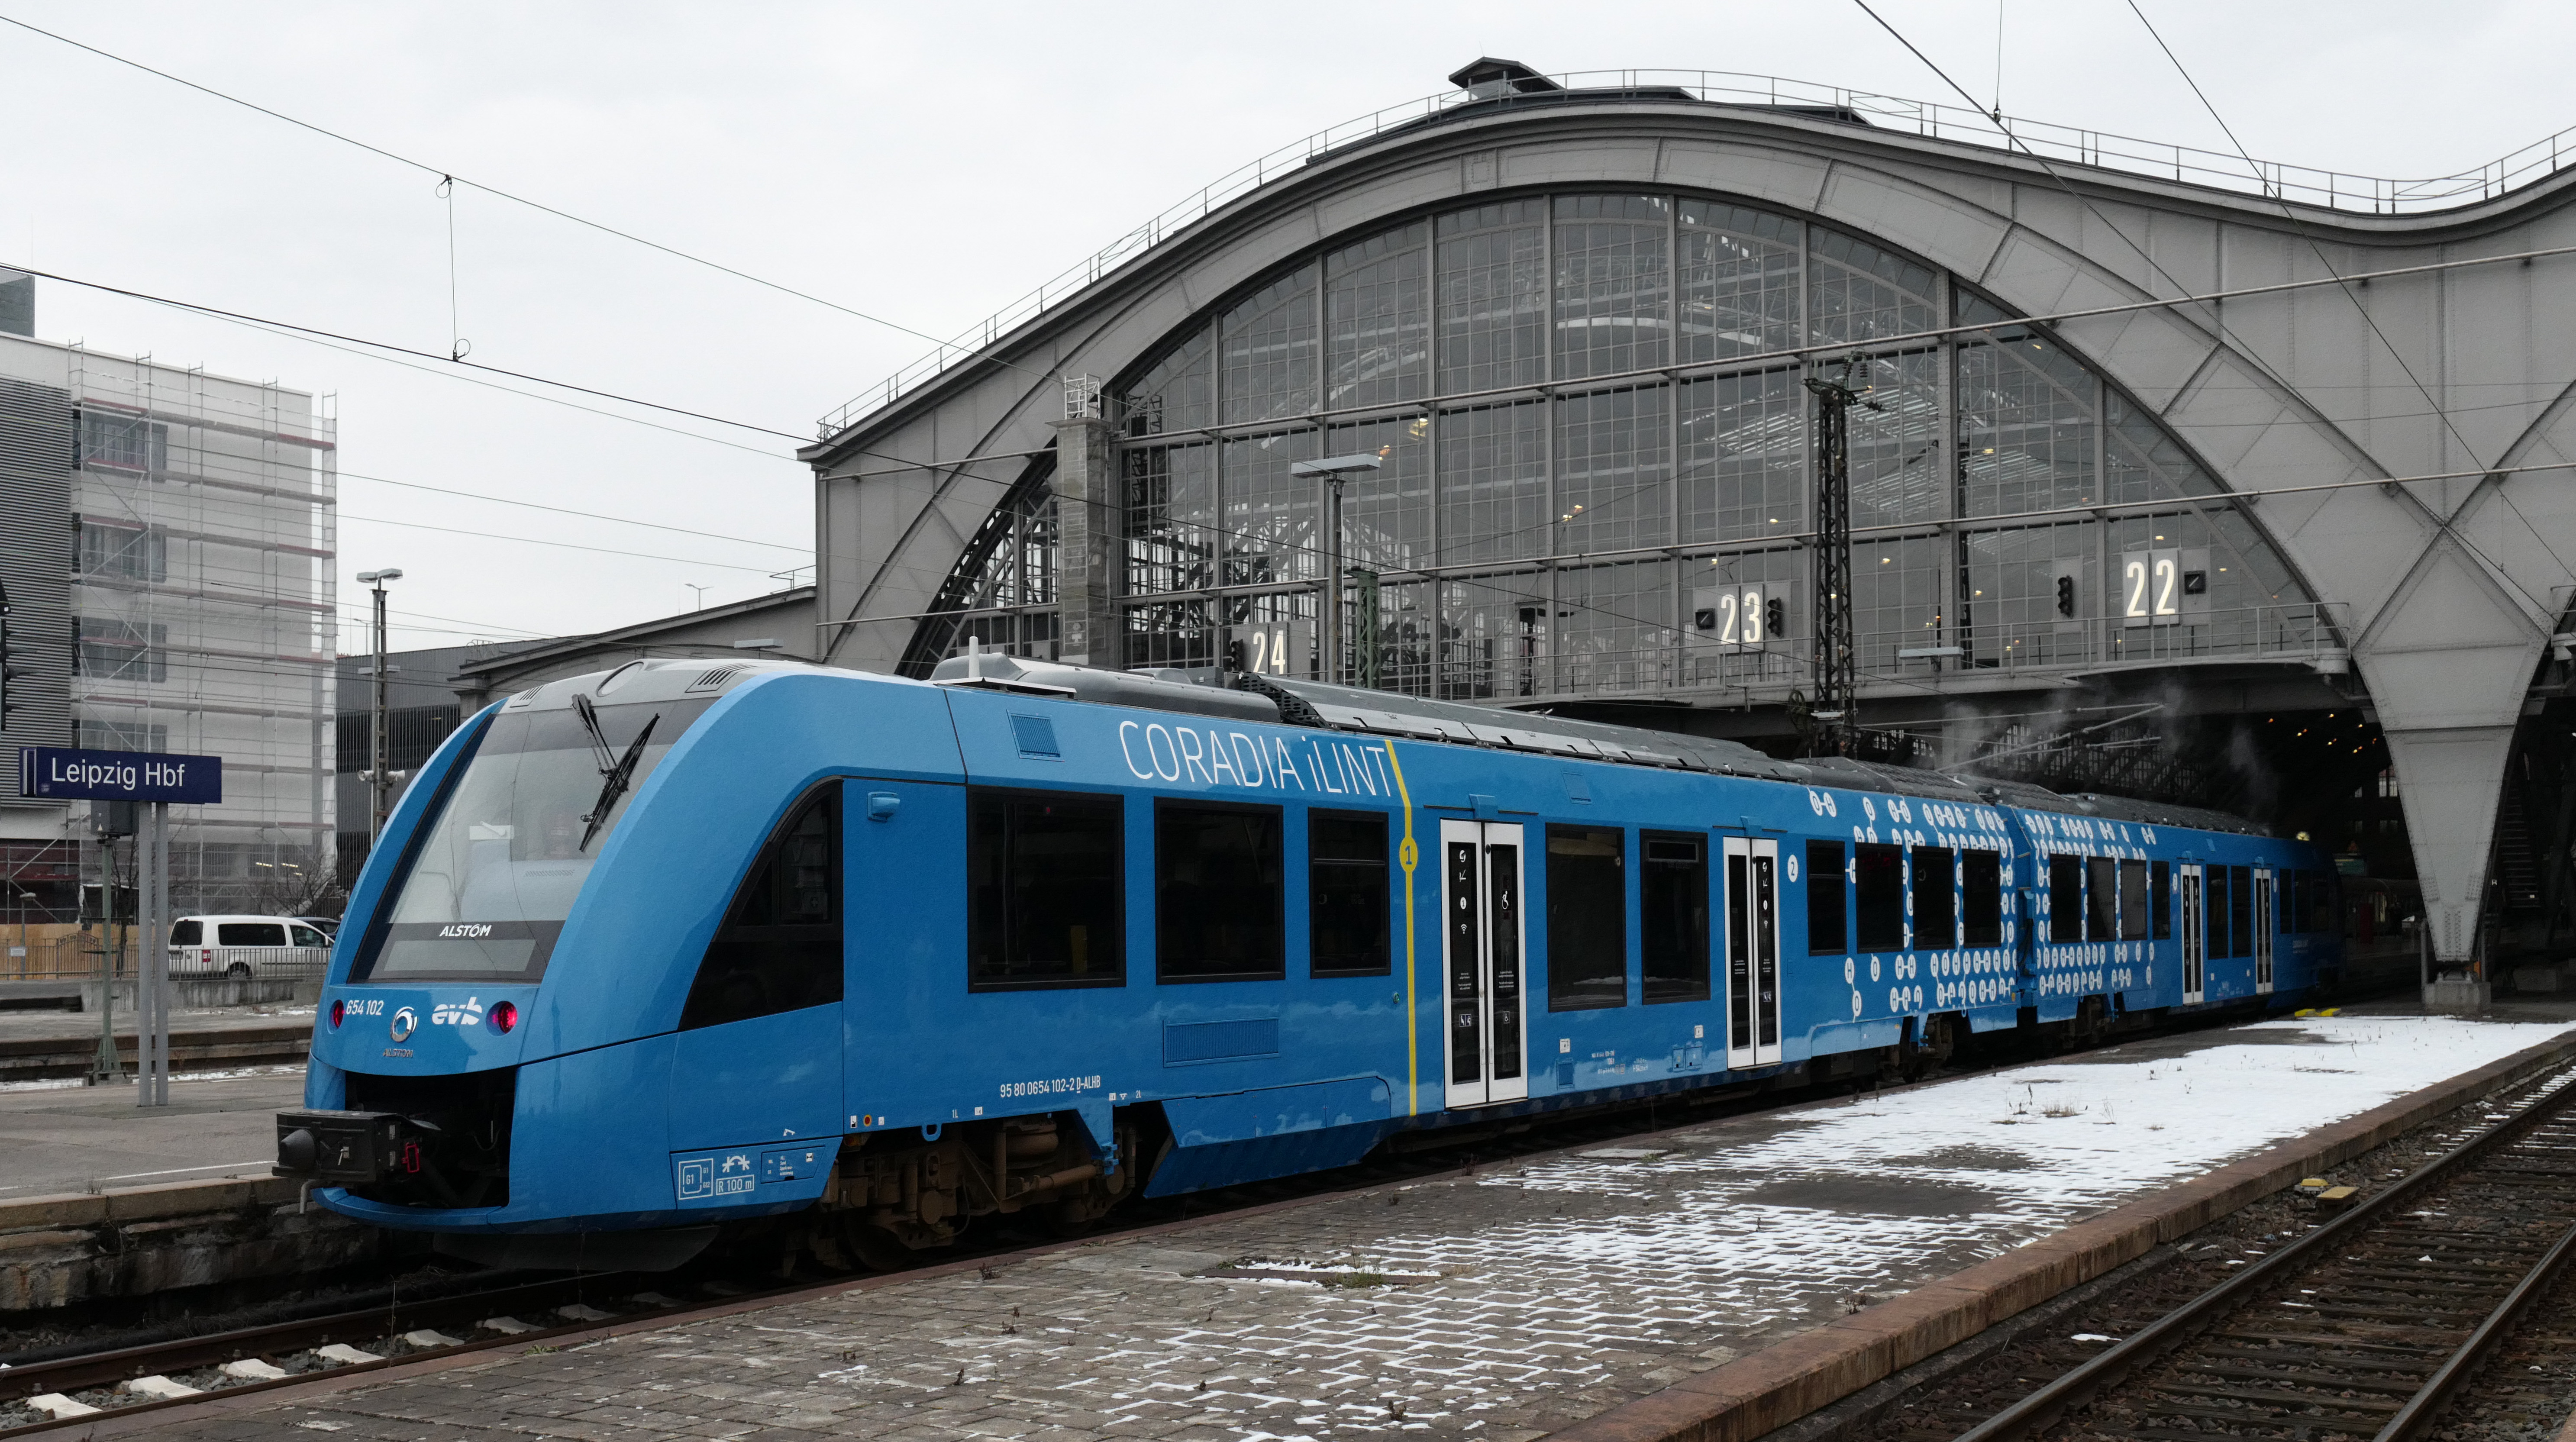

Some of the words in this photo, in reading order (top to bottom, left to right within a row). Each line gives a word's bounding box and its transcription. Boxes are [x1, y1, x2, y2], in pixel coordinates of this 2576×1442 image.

[2127, 559, 2175, 617] 22
[1721, 592, 1760, 644] 23
[1252, 630, 1285, 674] 24
[1119, 720, 1304, 790] CORADIA
[1301, 736, 1391, 797] iLINT
[52, 757, 136, 790] Leipzig
[146, 762, 185, 787] Hbf
[1405, 845, 1412, 865] 1
[439, 924, 492, 937] ALSTOM
[346, 1000, 364, 1015] 654
[366, 1000, 384, 1015] 102
[432, 997, 482, 1025] evb
[383, 1048, 413, 1058] ALSTOM
[1000, 1084, 1011, 1098] 95
[1014, 1082, 1025, 1097] 80
[1027, 1080, 1049, 1095] 0654
[1052, 1077, 1075, 1093] 102-2
[1076, 1075, 1101, 1093] D-ALHB
[1136, 1090, 1141, 1098] 2L
[952, 1109, 958, 1119] 1L
[686, 1174, 694, 1185] G1
[719, 1181, 723, 1193] R
[727, 1178, 742, 1190] 100
[745, 1181, 752, 1189] m
